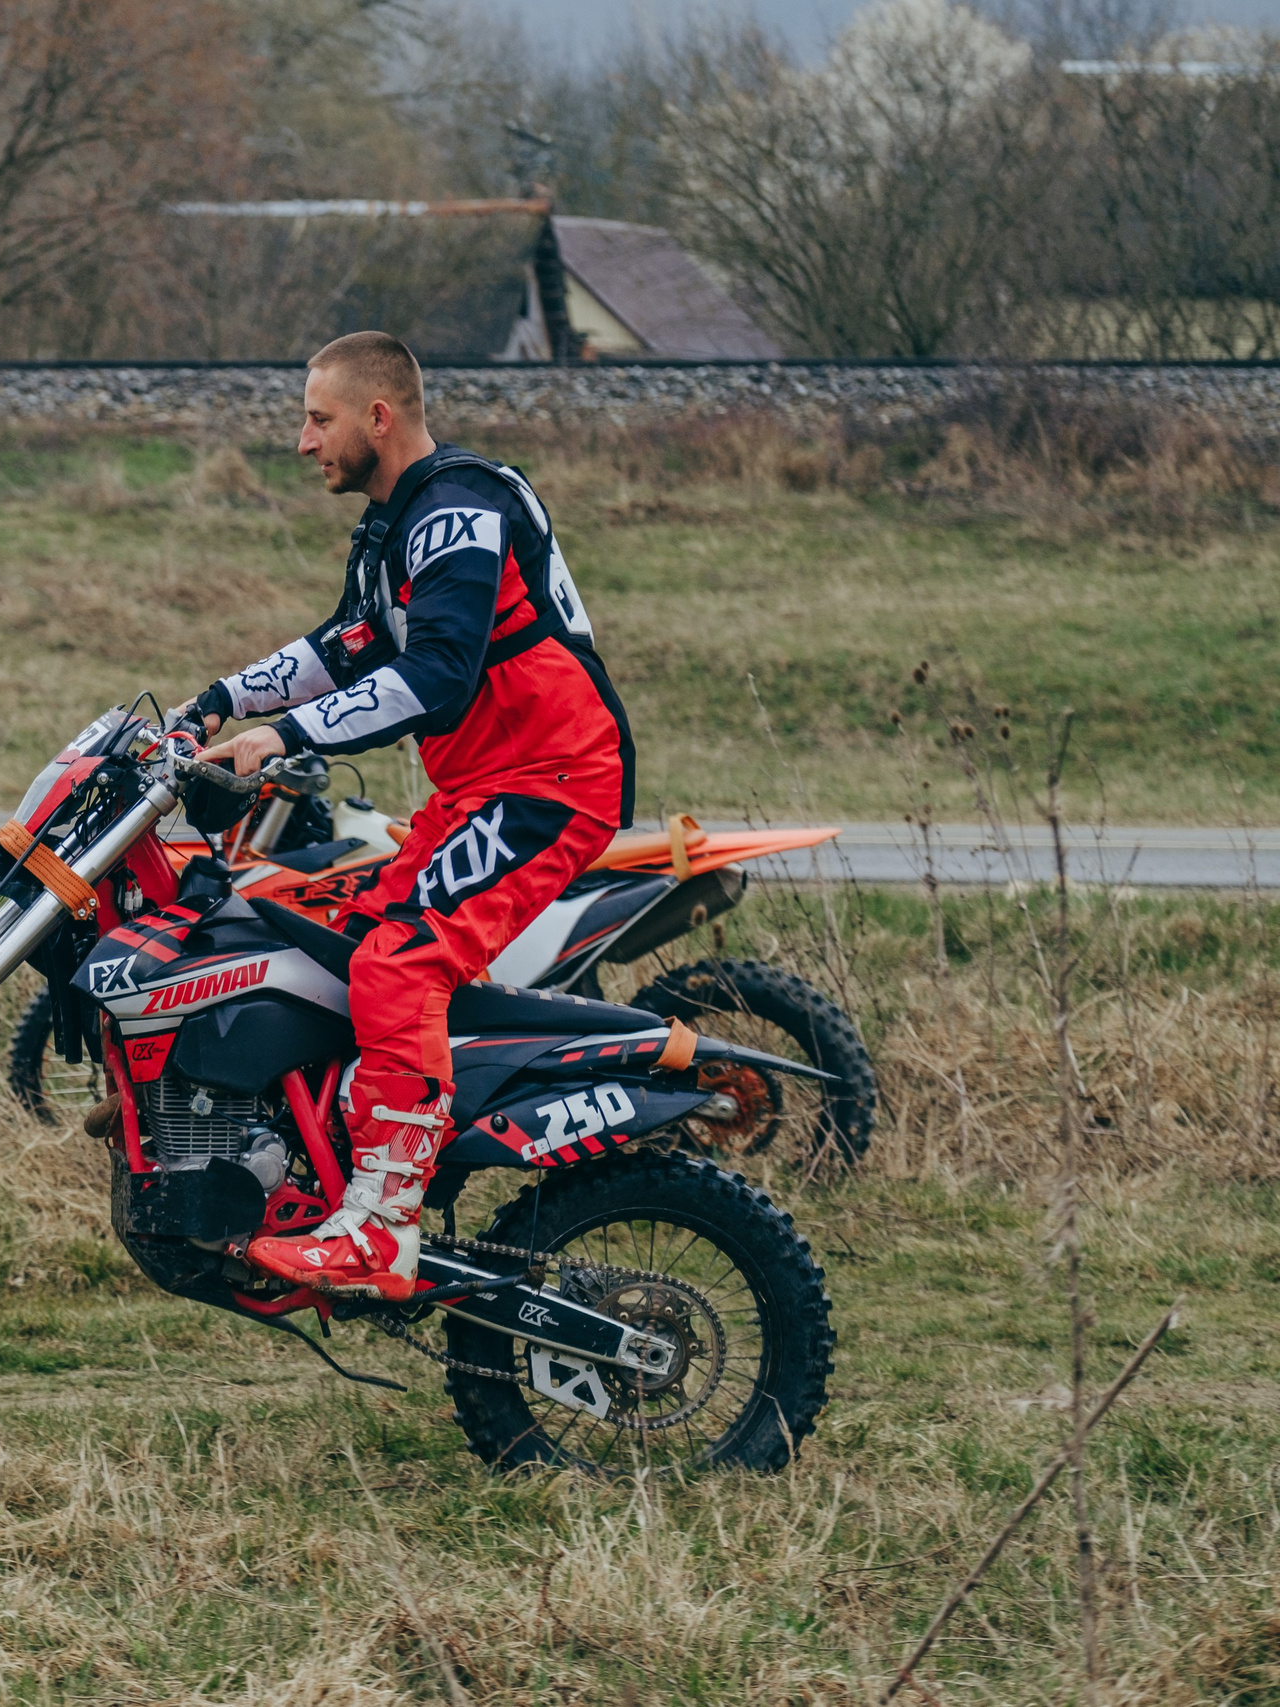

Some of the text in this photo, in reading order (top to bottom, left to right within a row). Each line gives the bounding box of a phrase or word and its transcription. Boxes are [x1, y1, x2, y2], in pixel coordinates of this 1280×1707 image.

[410, 511, 484, 569] FOX
[417, 801, 517, 908] FOX
[141, 959, 270, 1016] ZUUMAV
